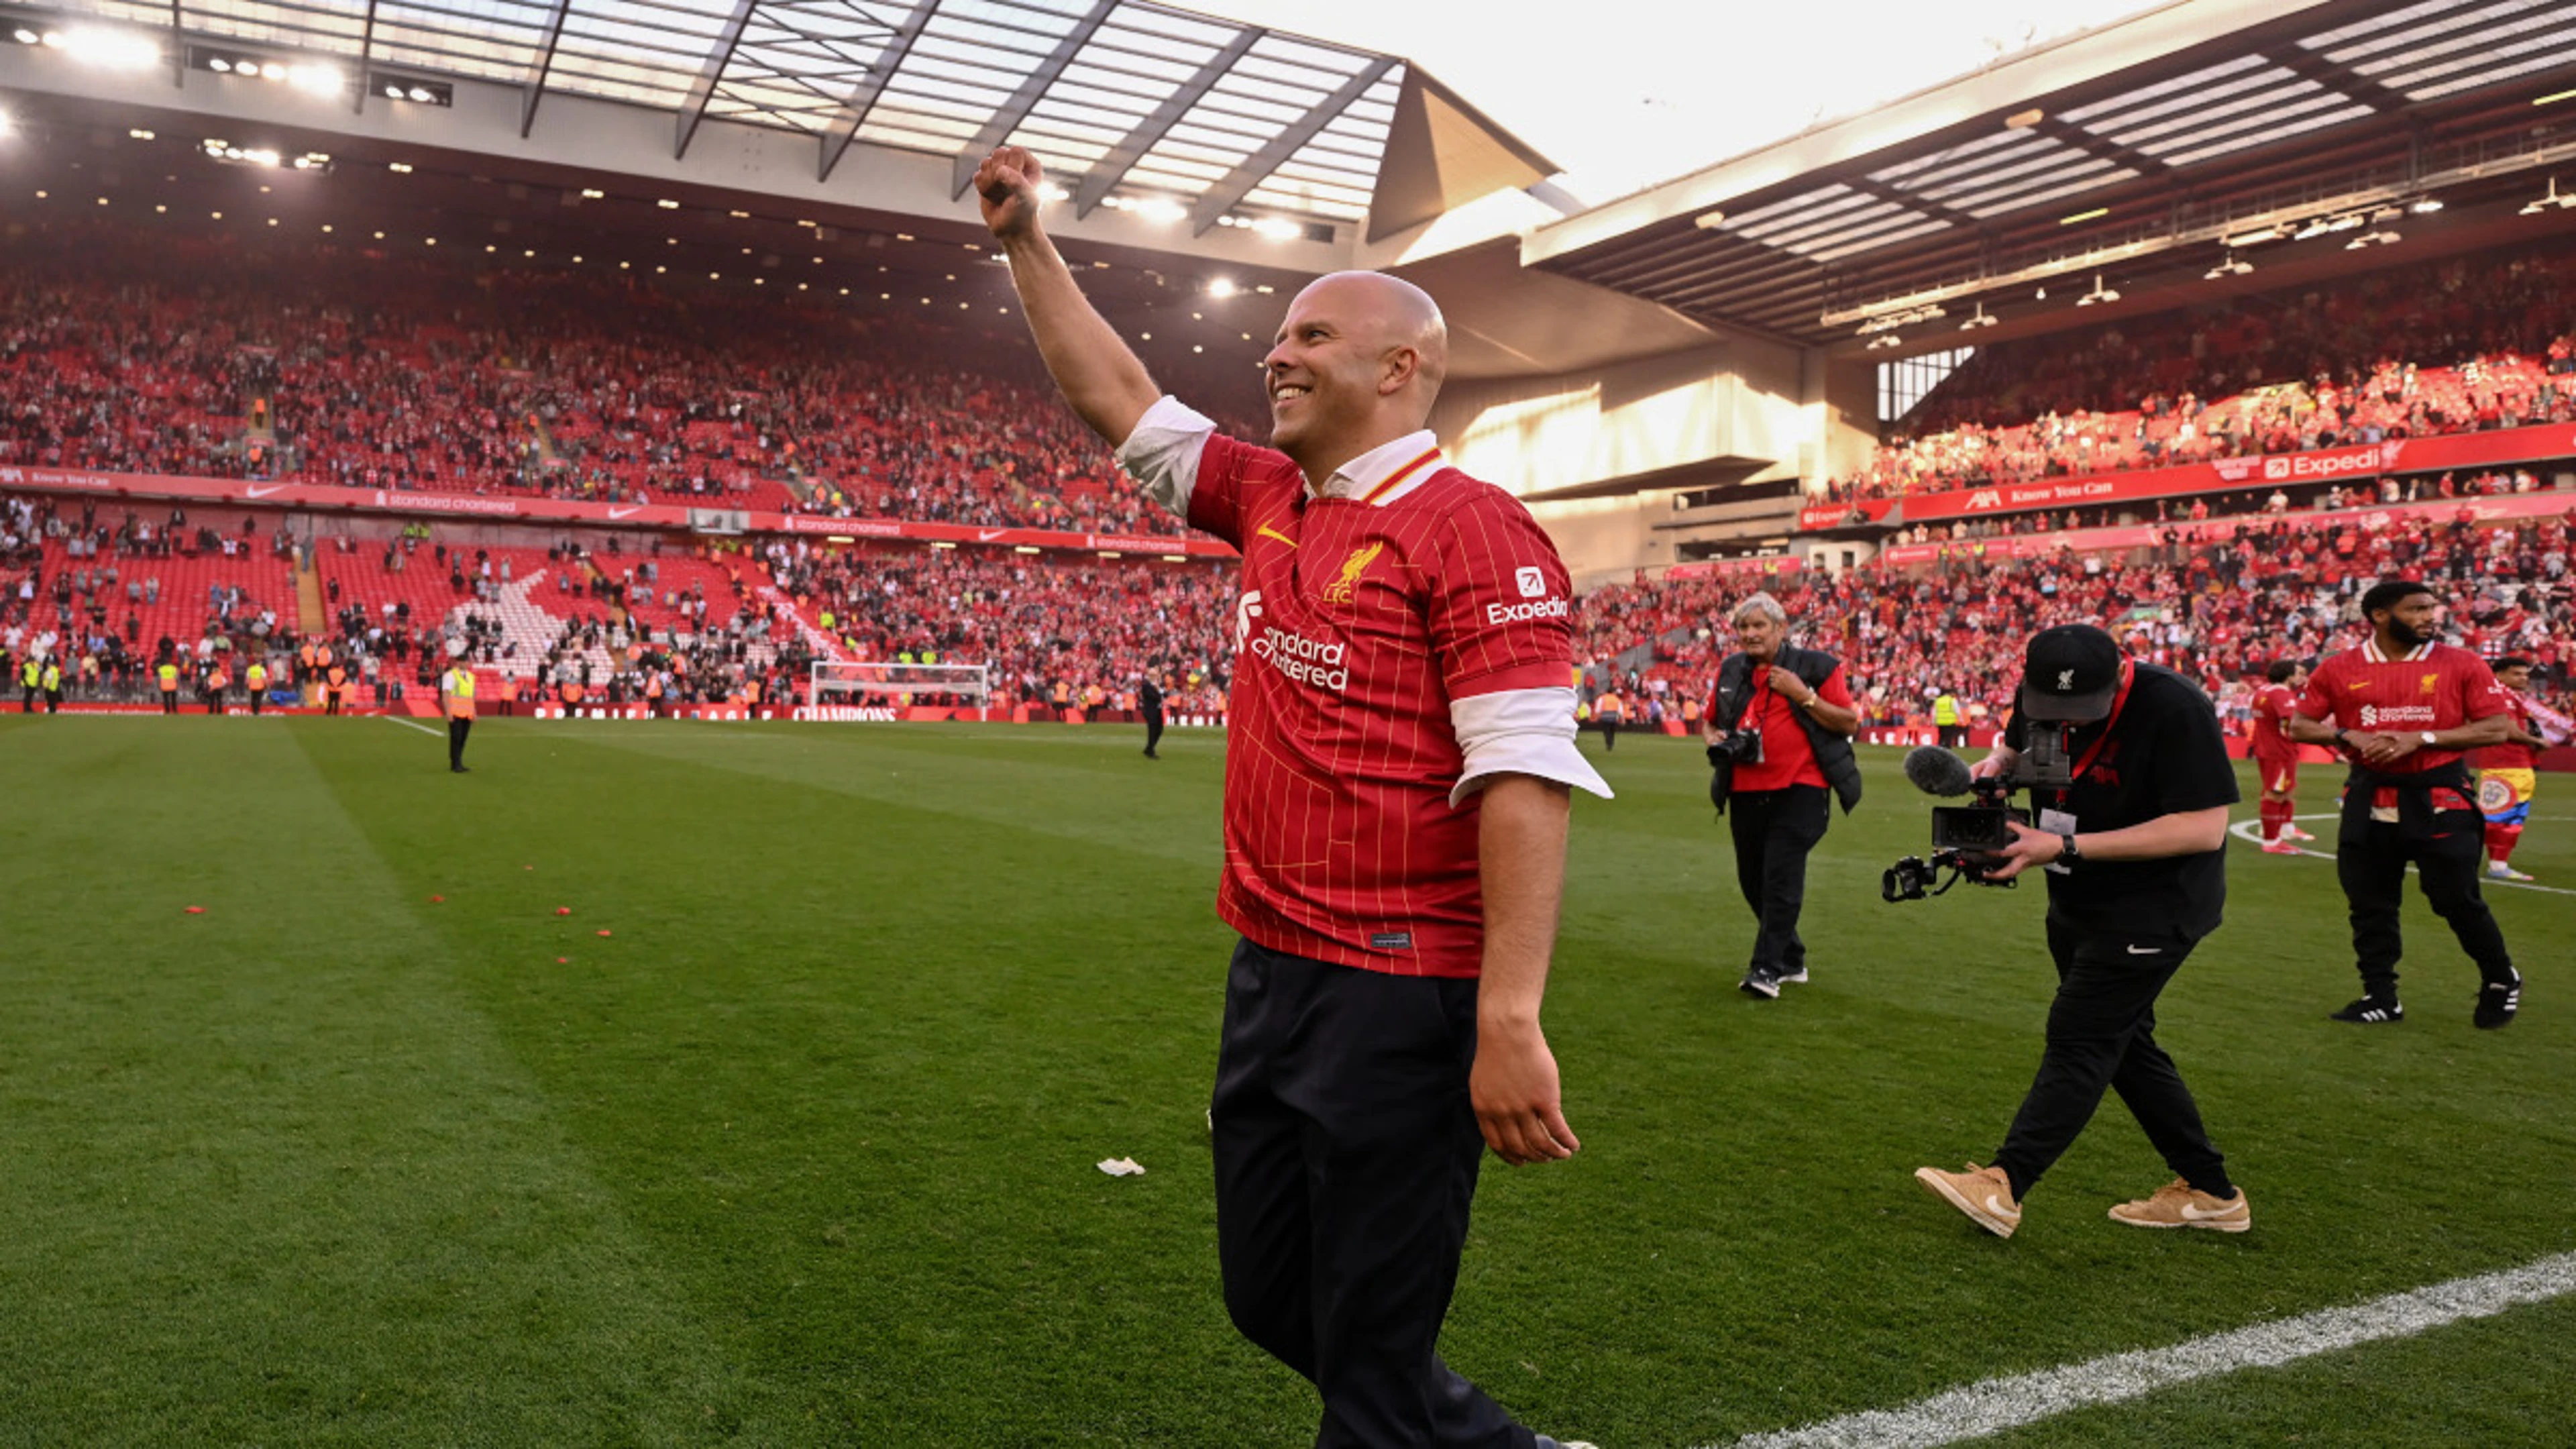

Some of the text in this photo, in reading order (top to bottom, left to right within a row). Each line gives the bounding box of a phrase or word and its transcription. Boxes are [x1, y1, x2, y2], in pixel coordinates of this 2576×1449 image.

[2294, 449, 2379, 476] Expedi
[1964, 490, 2002, 510] AXA
[2011, 481, 2112, 502] Know You Can
[390, 494, 516, 512] standard chartered
[796, 519, 900, 535] standard chartered
[1323, 588, 1354, 604] LFC
[793, 706, 896, 722] CHAMPIONS
